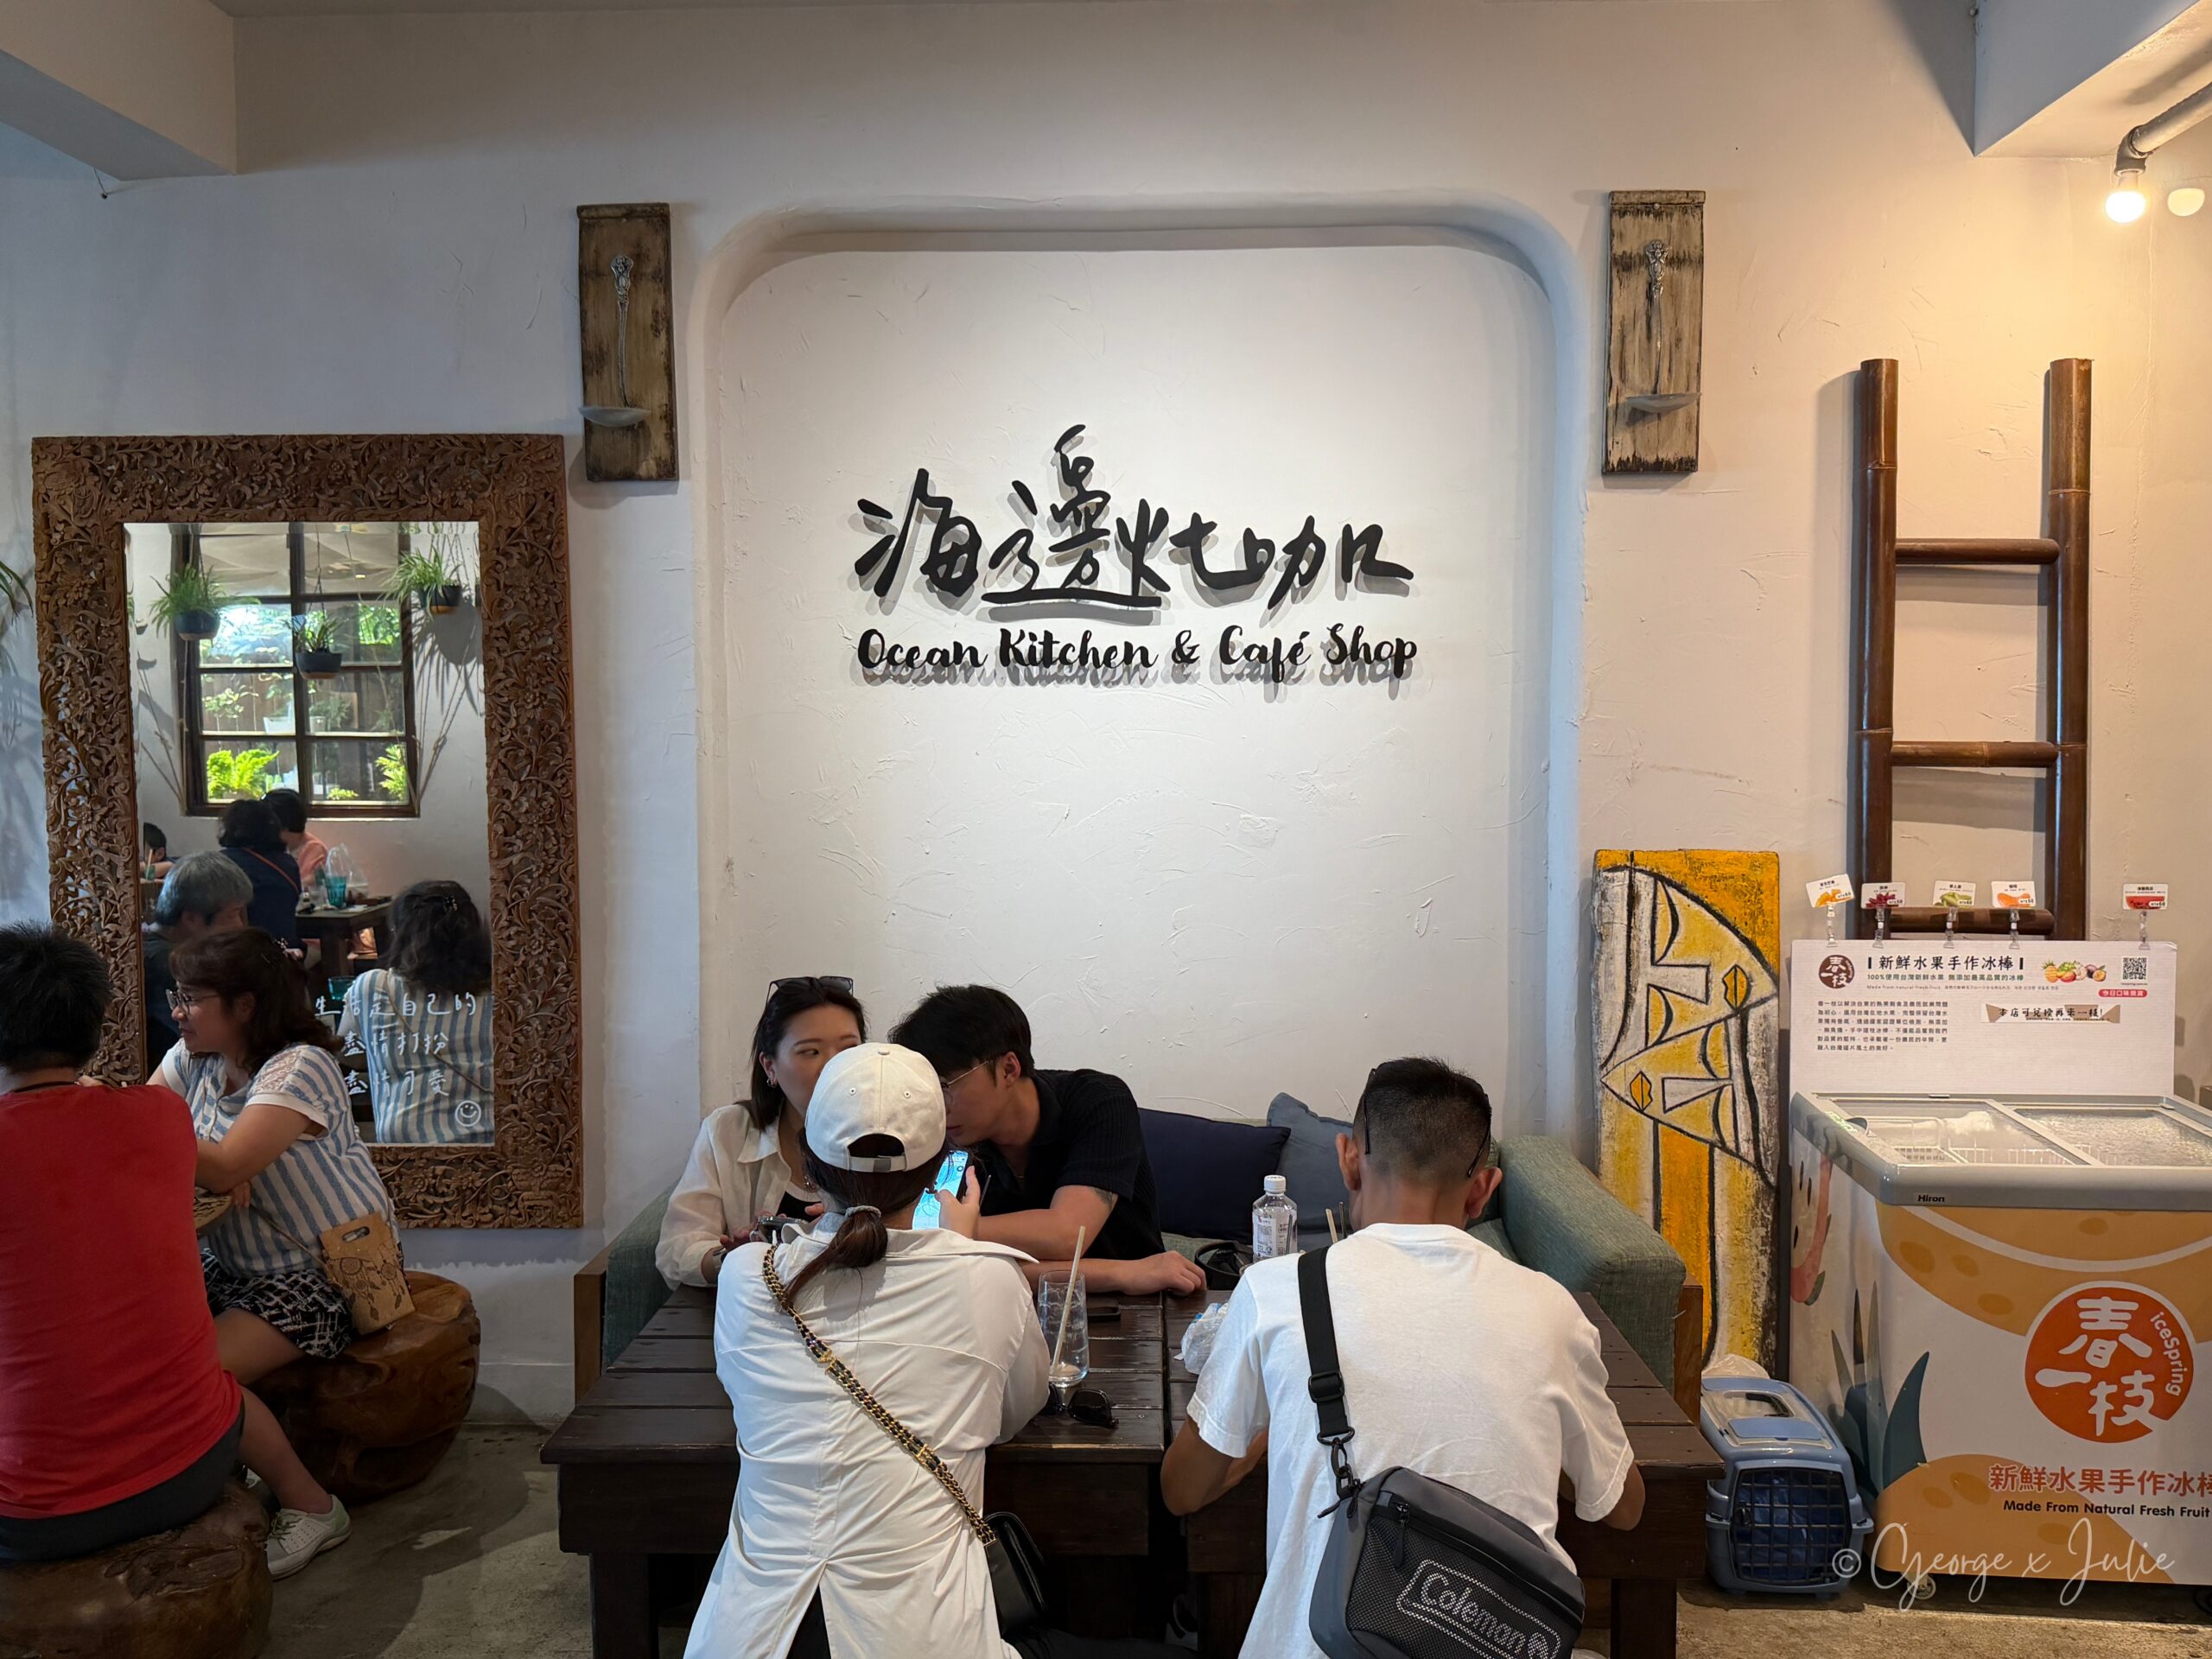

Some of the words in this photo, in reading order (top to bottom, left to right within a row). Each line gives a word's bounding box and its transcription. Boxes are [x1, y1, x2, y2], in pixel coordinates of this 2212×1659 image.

[858, 628, 987, 669] Ocean
[1000, 628, 1158, 669] Kitchen
[1172, 630, 1200, 664] &
[1220, 625, 1312, 683] Café
[1325, 623, 1418, 678] Shop
[1878, 955, 2014, 970] 新鮮水果手作冰棒
[315, 992, 476, 1016] 生活是自己的
[1917, 1193, 1946, 1204] Hiron
[2149, 1311, 2183, 1397] iceSpring
[2003, 1500, 2042, 1512] Made
[2046, 1502, 2079, 1514] From
[2084, 1503, 2134, 1515] Natural
[2139, 1504, 2175, 1516] Fresh
[2180, 1506, 2210, 1518] Fruit
[1421, 1573, 1527, 1655] Coleman
